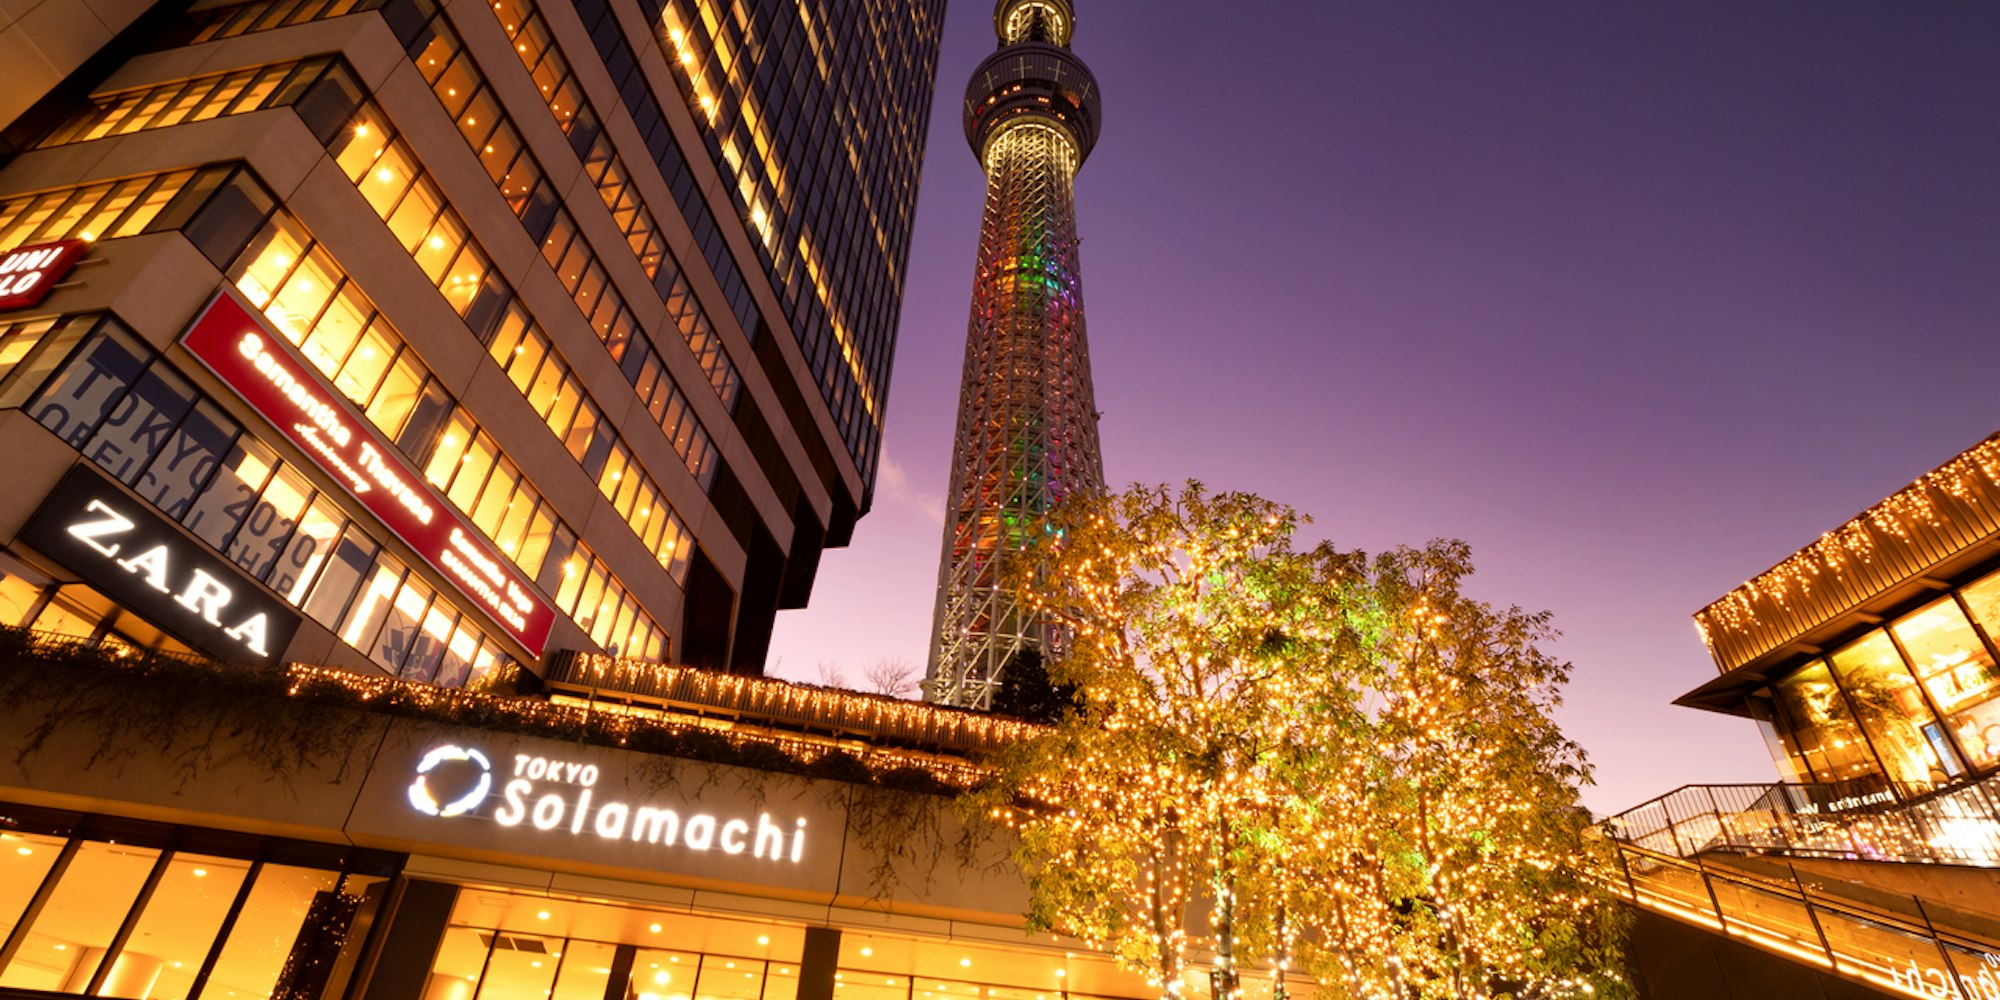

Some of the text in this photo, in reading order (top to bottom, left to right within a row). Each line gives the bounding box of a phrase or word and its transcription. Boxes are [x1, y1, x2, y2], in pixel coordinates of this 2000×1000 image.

[0, 246, 64, 275] UNI
[72, 352, 318, 569] TOKYO 2020
[238, 332, 434, 526] Samantha Thavasa
[67, 499, 270, 658] ZARA
[496, 779, 808, 864] Solamachi
[513, 754, 600, 787] TOKYO
